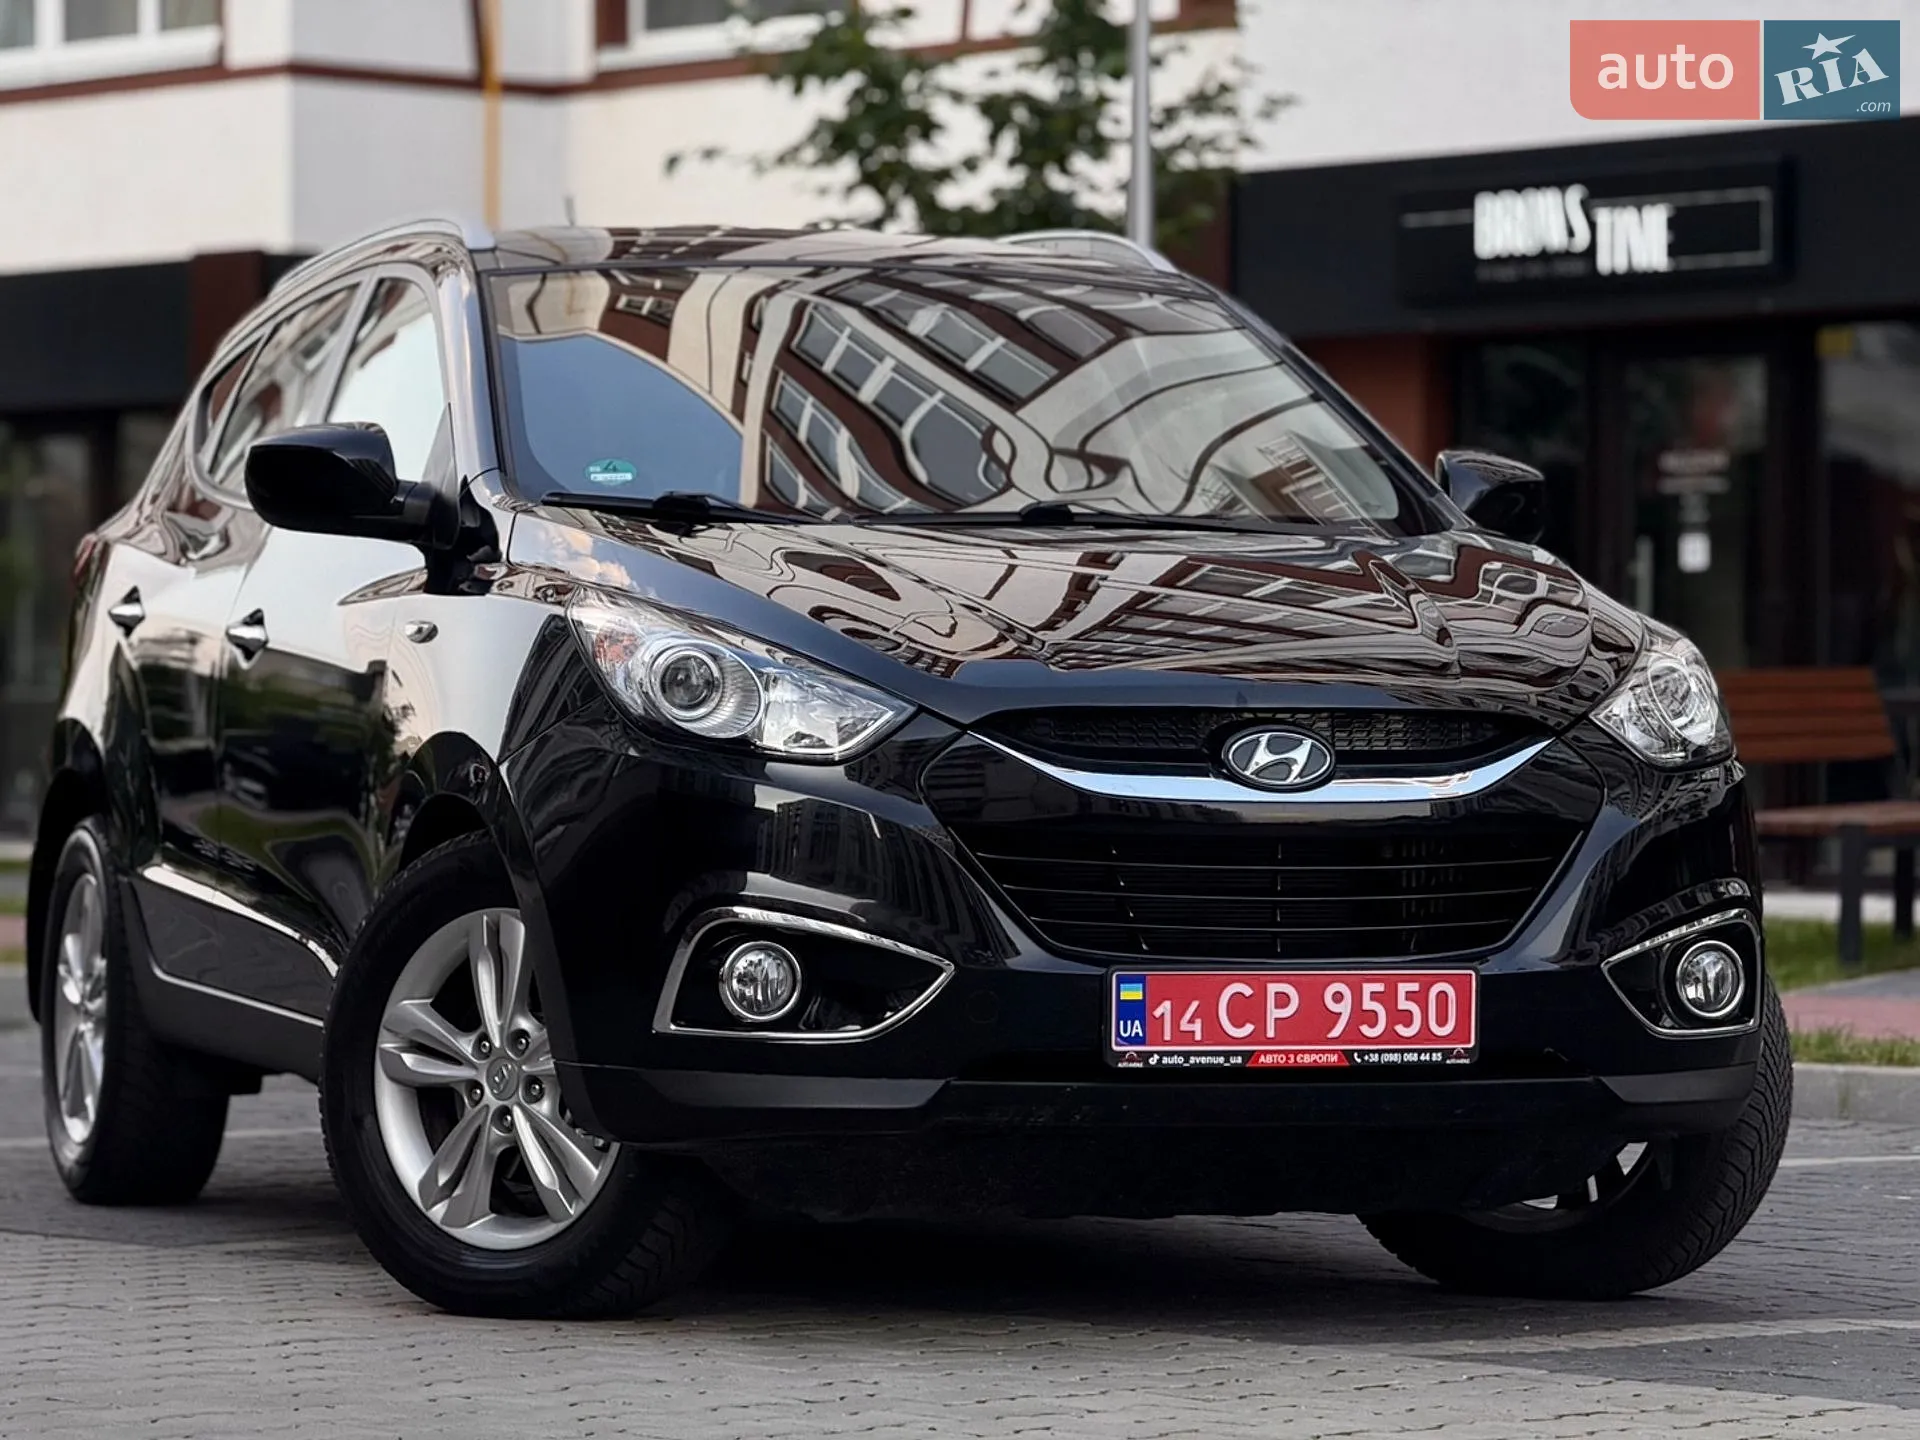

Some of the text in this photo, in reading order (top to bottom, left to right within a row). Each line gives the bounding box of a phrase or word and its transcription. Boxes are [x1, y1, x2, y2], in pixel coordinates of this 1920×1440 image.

[1152, 981, 1457, 1041] 14 CP 9550
[1119, 1020, 1143, 1037] UA
[1161, 1054, 1242, 1067] auto_avenue_ua
[1258, 1053, 1287, 1064] АВТО
[1296, 1053, 1339, 1064] ЄВРОПИ
[1363, 1053, 1380, 1062] +38
